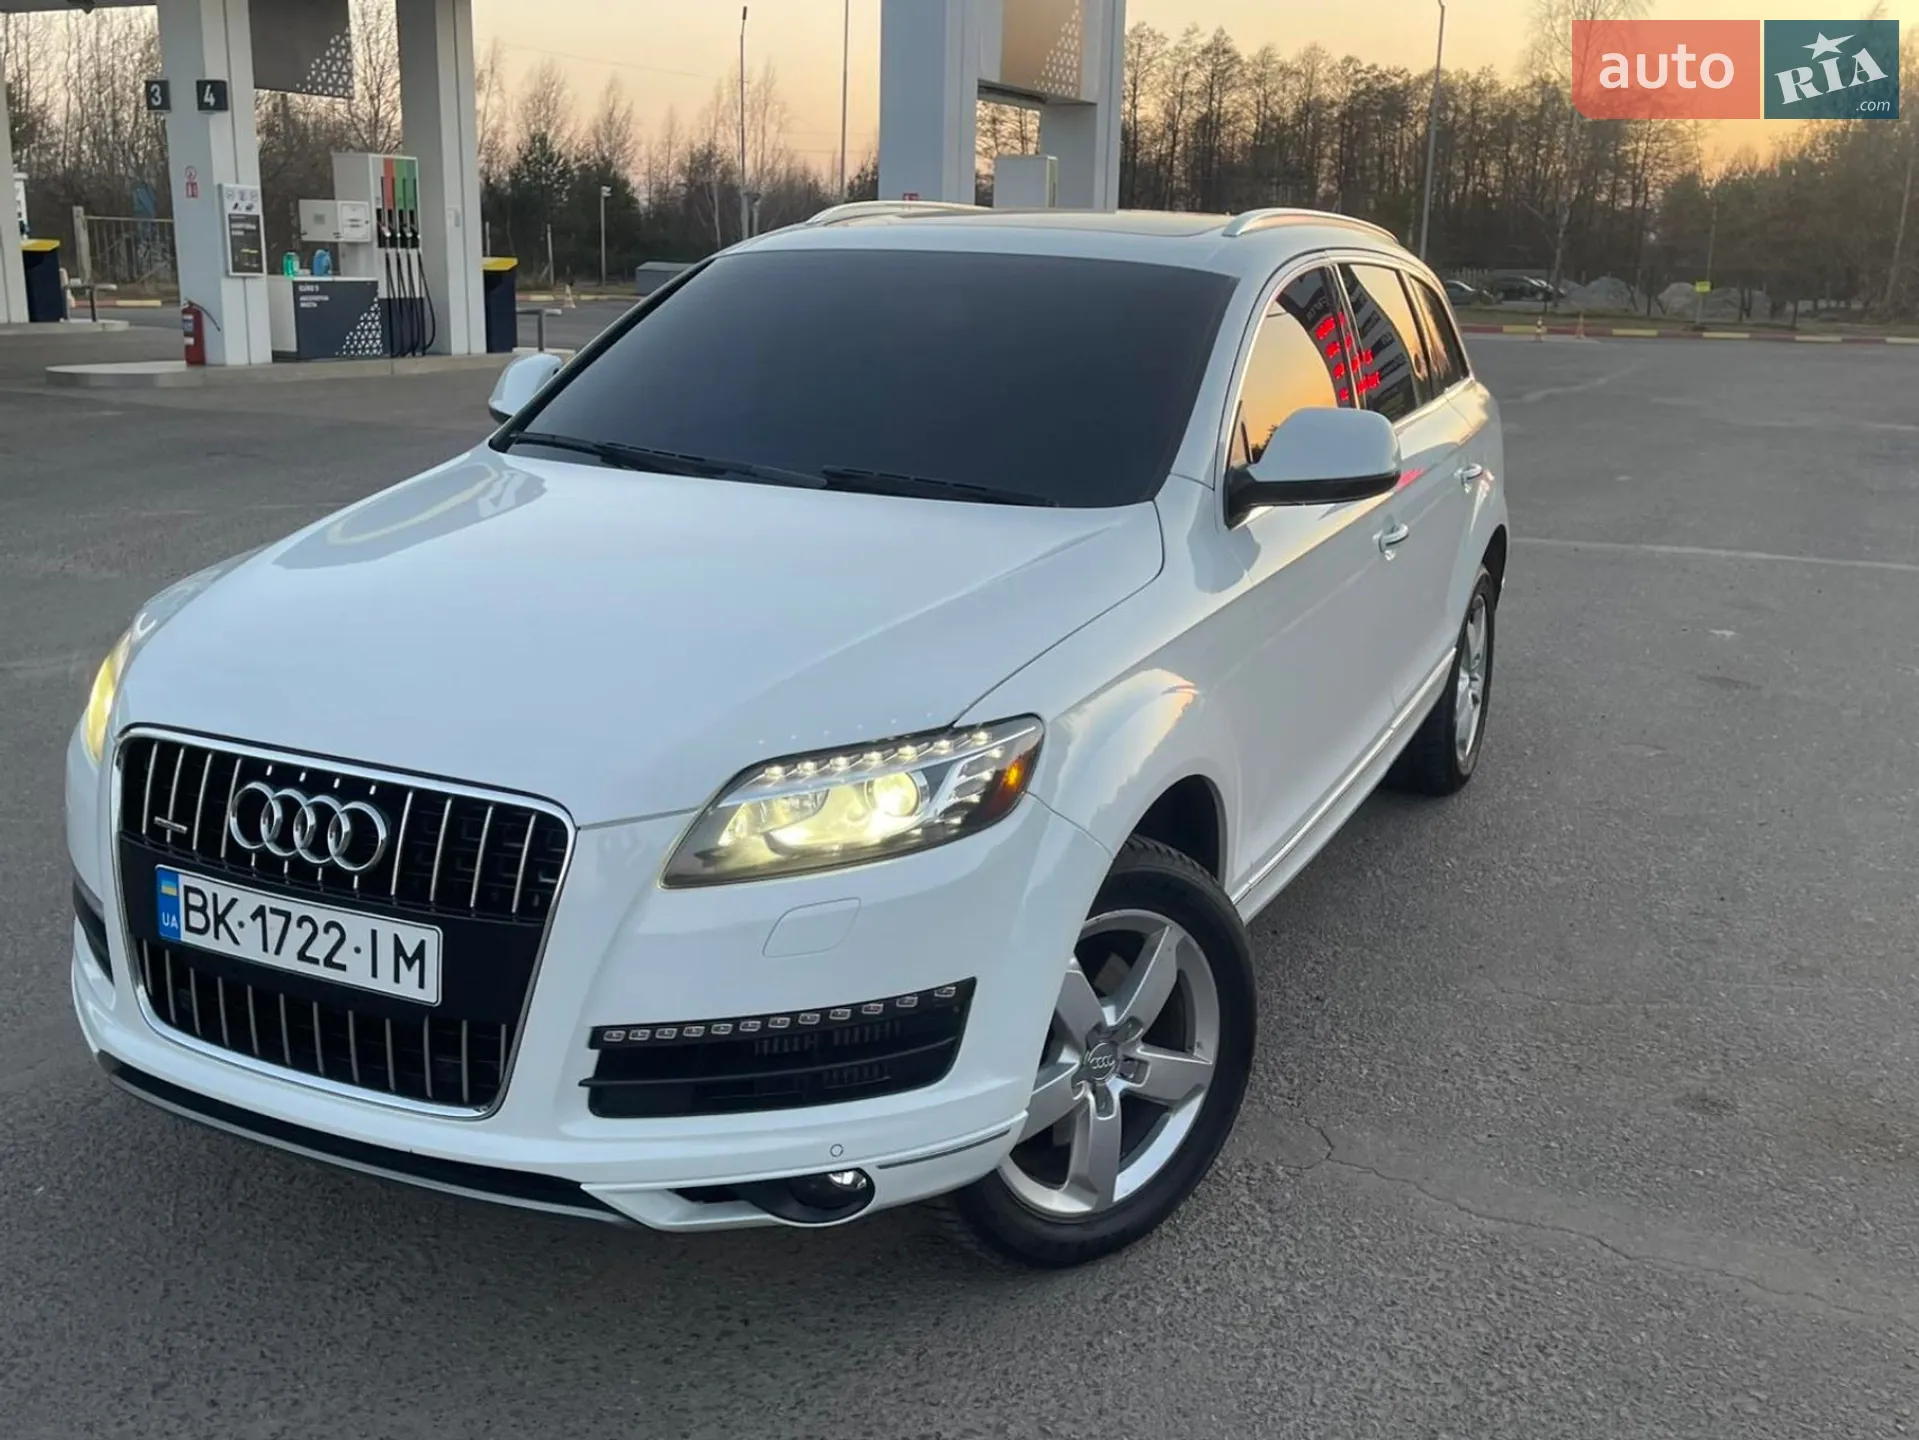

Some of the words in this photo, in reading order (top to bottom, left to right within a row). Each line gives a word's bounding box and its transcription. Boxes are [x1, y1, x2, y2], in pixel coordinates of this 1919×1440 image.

[149, 83, 162, 106] 3
[203, 83, 216, 107] 4
[161, 914, 179, 930] UA
